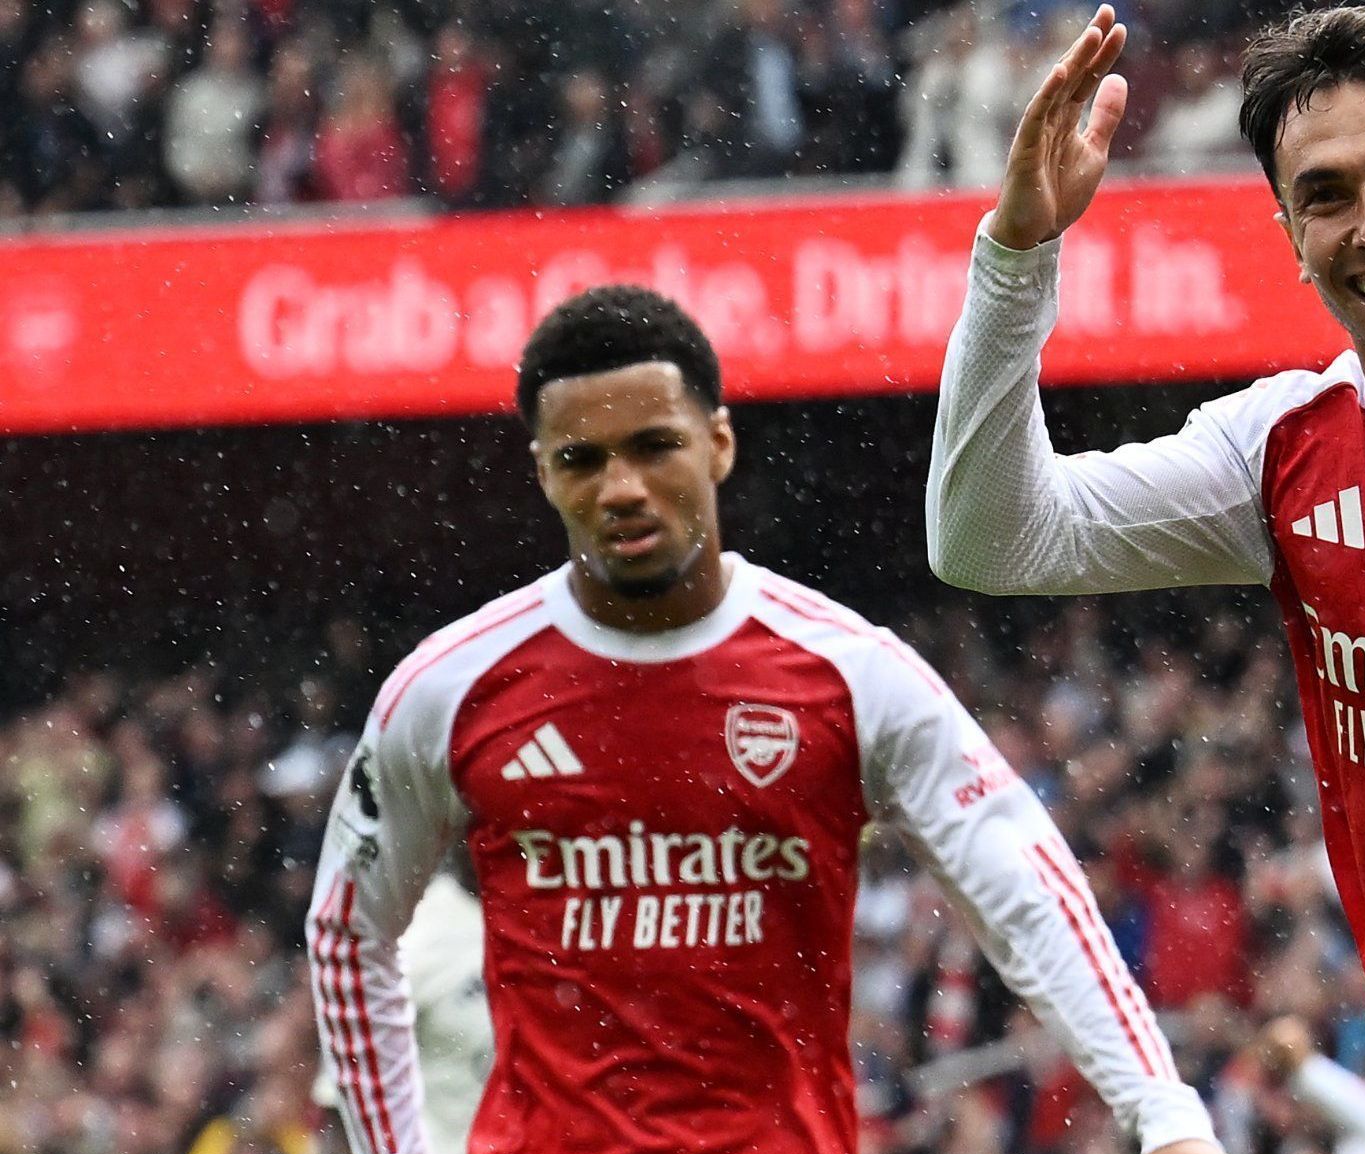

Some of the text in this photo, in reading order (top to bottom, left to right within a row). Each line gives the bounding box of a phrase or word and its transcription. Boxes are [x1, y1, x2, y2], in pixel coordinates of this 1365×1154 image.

[238, 262, 460, 380] Grab
[466, 276, 526, 368] a
[514, 820, 810, 889] Emirates
[561, 890, 764, 950] FLY BETTER
